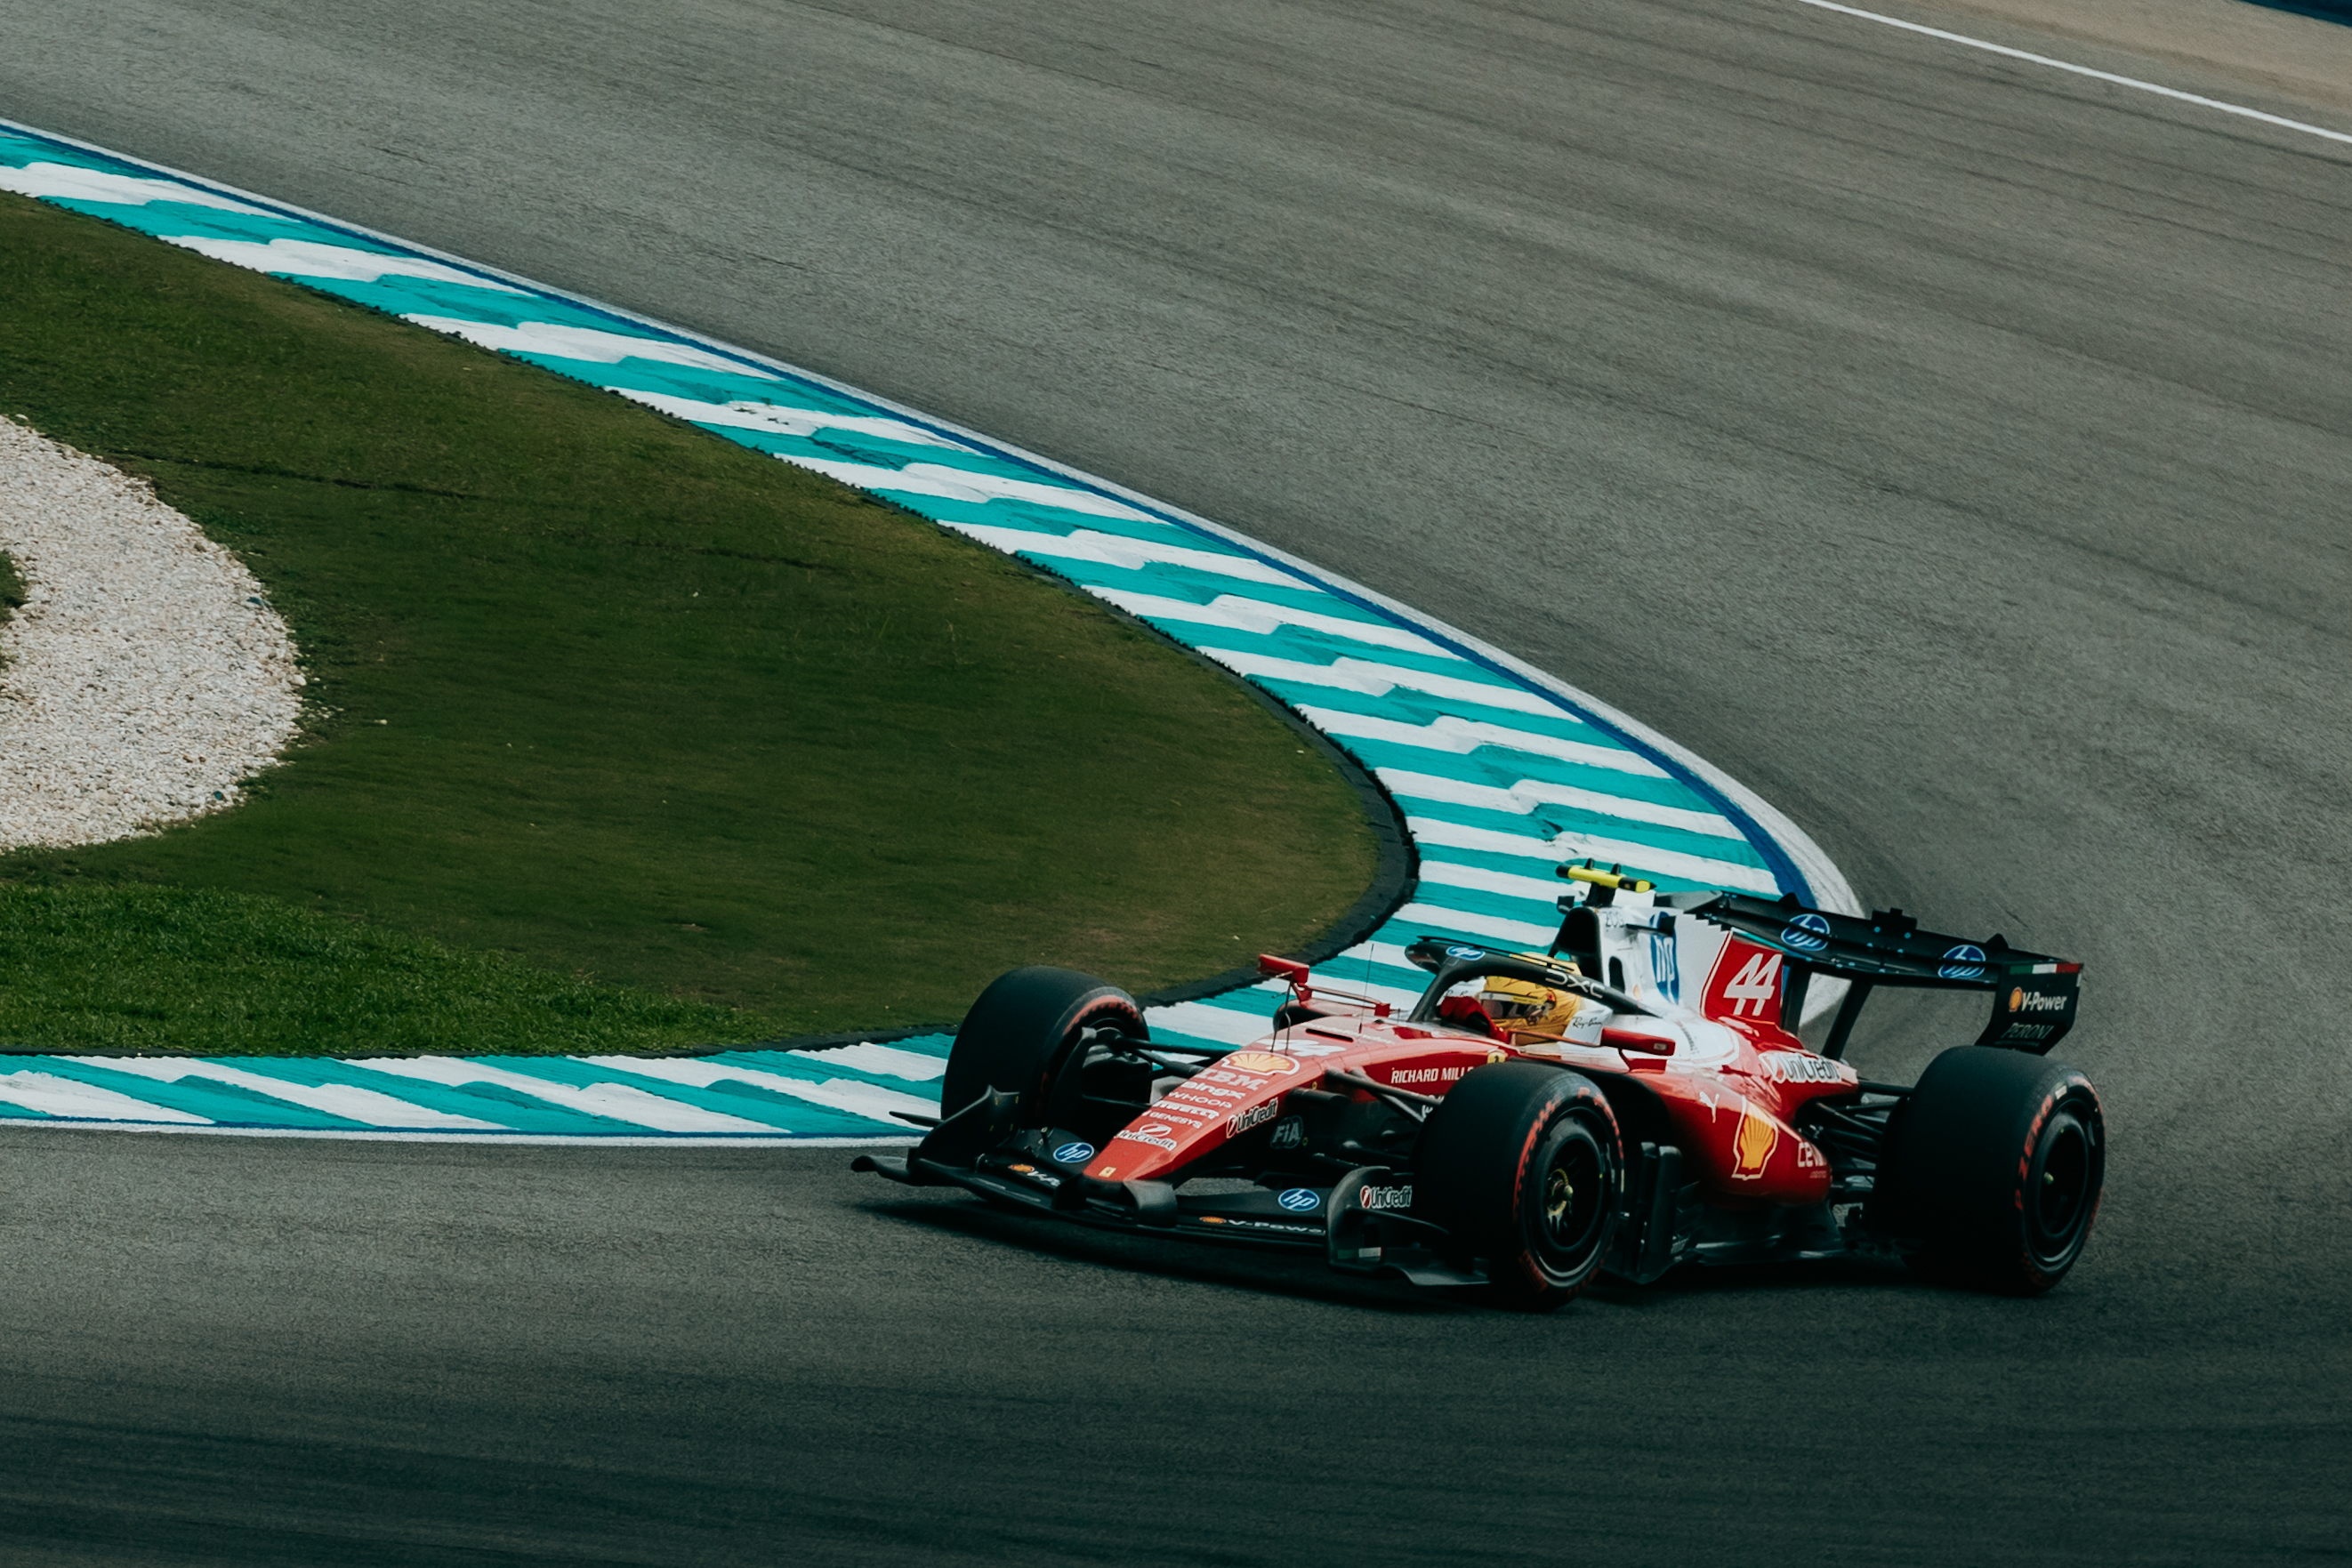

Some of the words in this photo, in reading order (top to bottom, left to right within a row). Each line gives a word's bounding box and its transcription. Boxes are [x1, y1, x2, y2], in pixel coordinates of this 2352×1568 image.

[1723, 953, 1783, 1016] 44
[2021, 992, 2067, 1011] V-Power
[2001, 1023, 2056, 1040] PERONI
[1194, 1068, 1269, 1091] IBM
[1390, 1067, 1439, 1083] RICHARD
[1441, 1066, 1474, 1081] MILL
[1169, 1091, 1232, 1108] WHOOP
[1150, 1111, 1203, 1130] GENESYS
[1236, 1098, 1277, 1132] UniCredit
[1053, 1142, 1094, 1162] hp
[1278, 1188, 1320, 1210] hp
[1371, 1186, 1411, 1208] UniCredit
[1228, 1218, 1326, 1234] V-Powe
